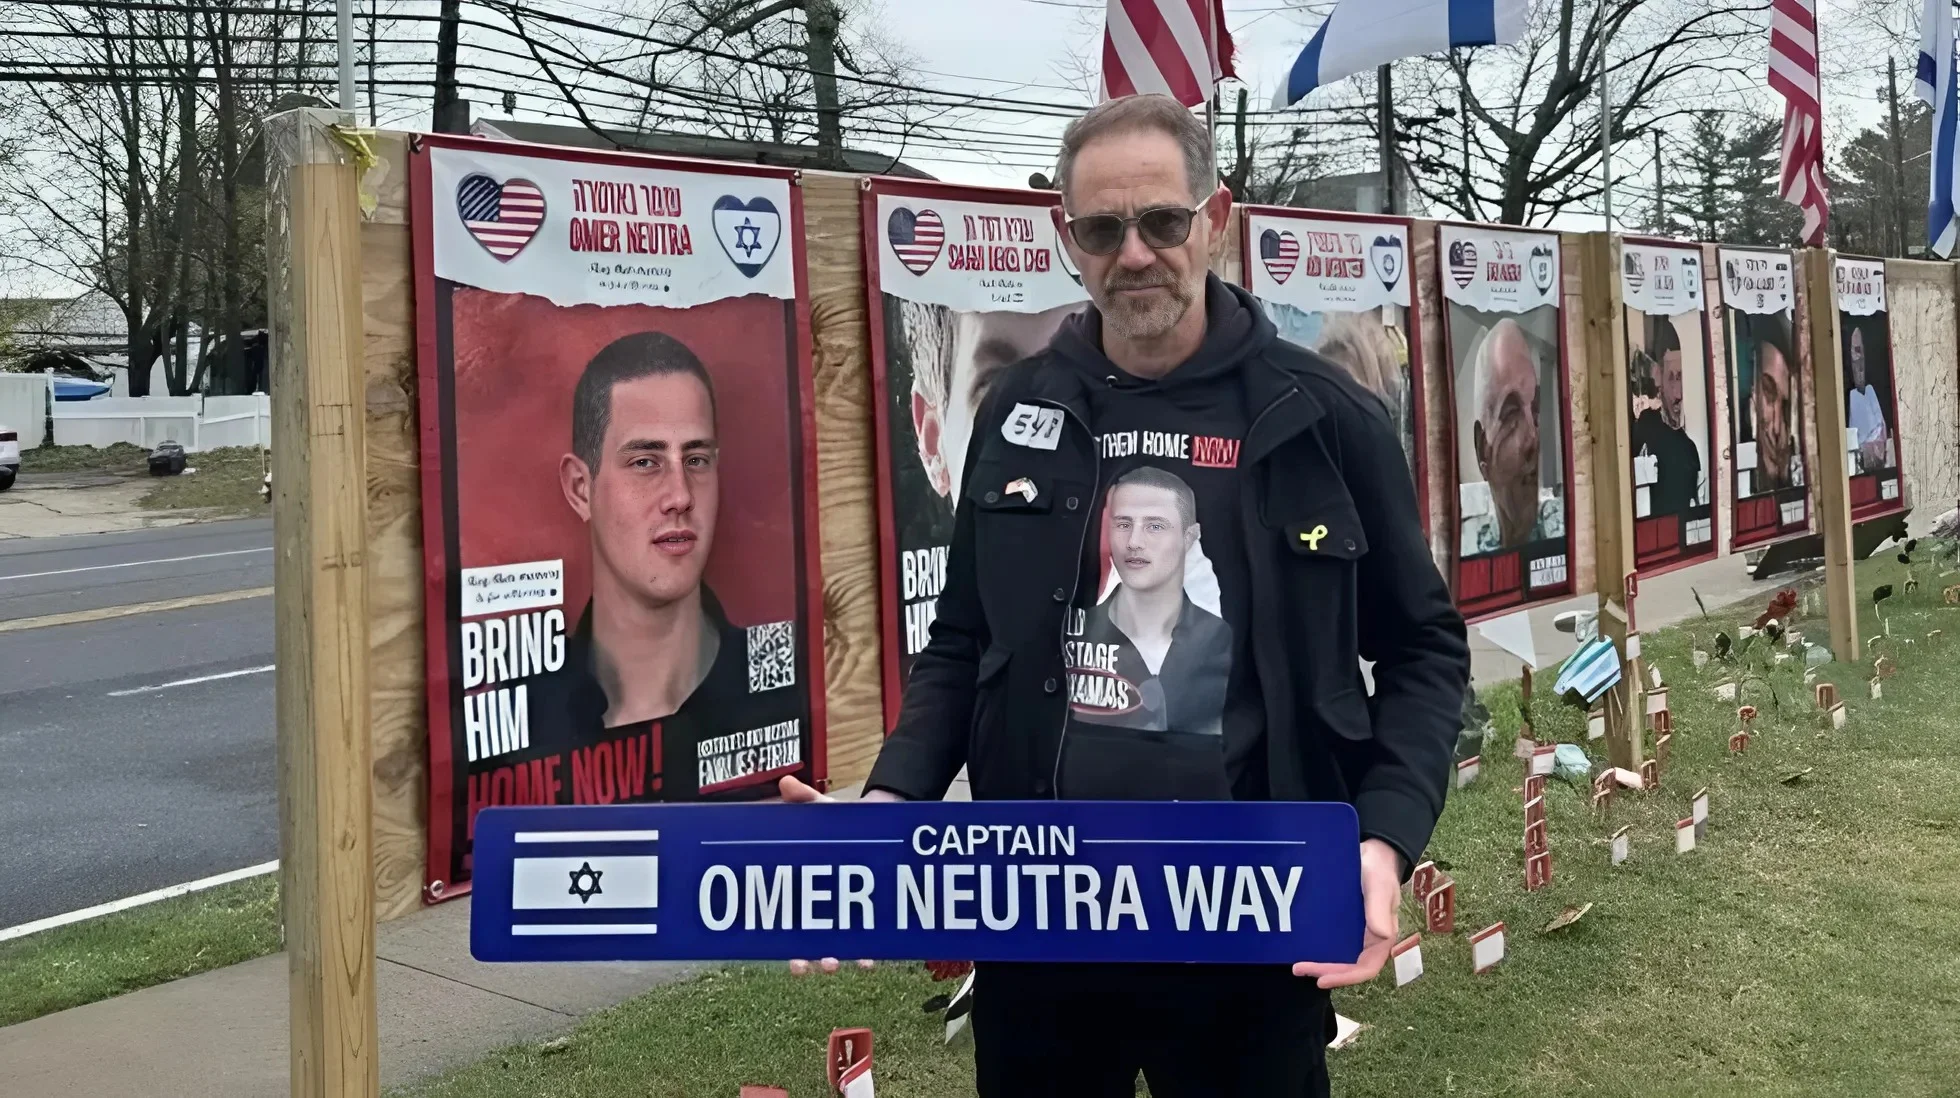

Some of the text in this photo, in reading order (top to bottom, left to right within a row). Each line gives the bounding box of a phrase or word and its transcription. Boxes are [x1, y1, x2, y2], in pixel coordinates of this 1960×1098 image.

[570, 217, 693, 256] OMER NEUTRA
[1142, 430, 1190, 460] HOME
[902, 545, 950, 600] BRIN
[462, 609, 565, 689] BRING
[1065, 641, 1120, 674] STAGE
[464, 684, 529, 762] HIM
[571, 722, 663, 805] NOW!
[912, 825, 1075, 856] CAPTAIN
[699, 864, 1303, 932] OMER NEUTRA WAY
